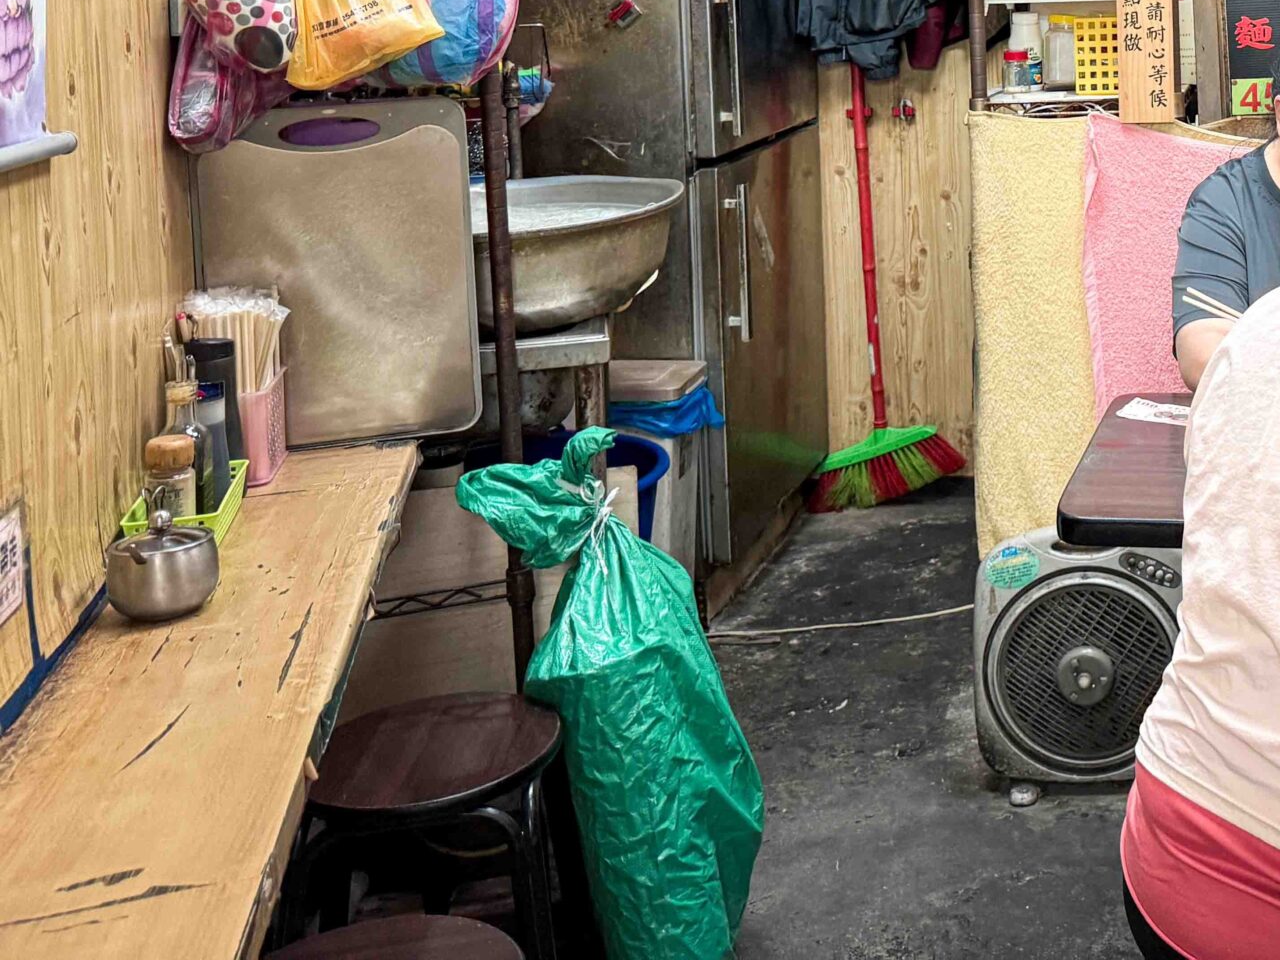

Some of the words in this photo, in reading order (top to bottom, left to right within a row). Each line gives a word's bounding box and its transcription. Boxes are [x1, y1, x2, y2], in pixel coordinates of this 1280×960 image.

[1146, 2, 1168, 109] 請耐心等候
